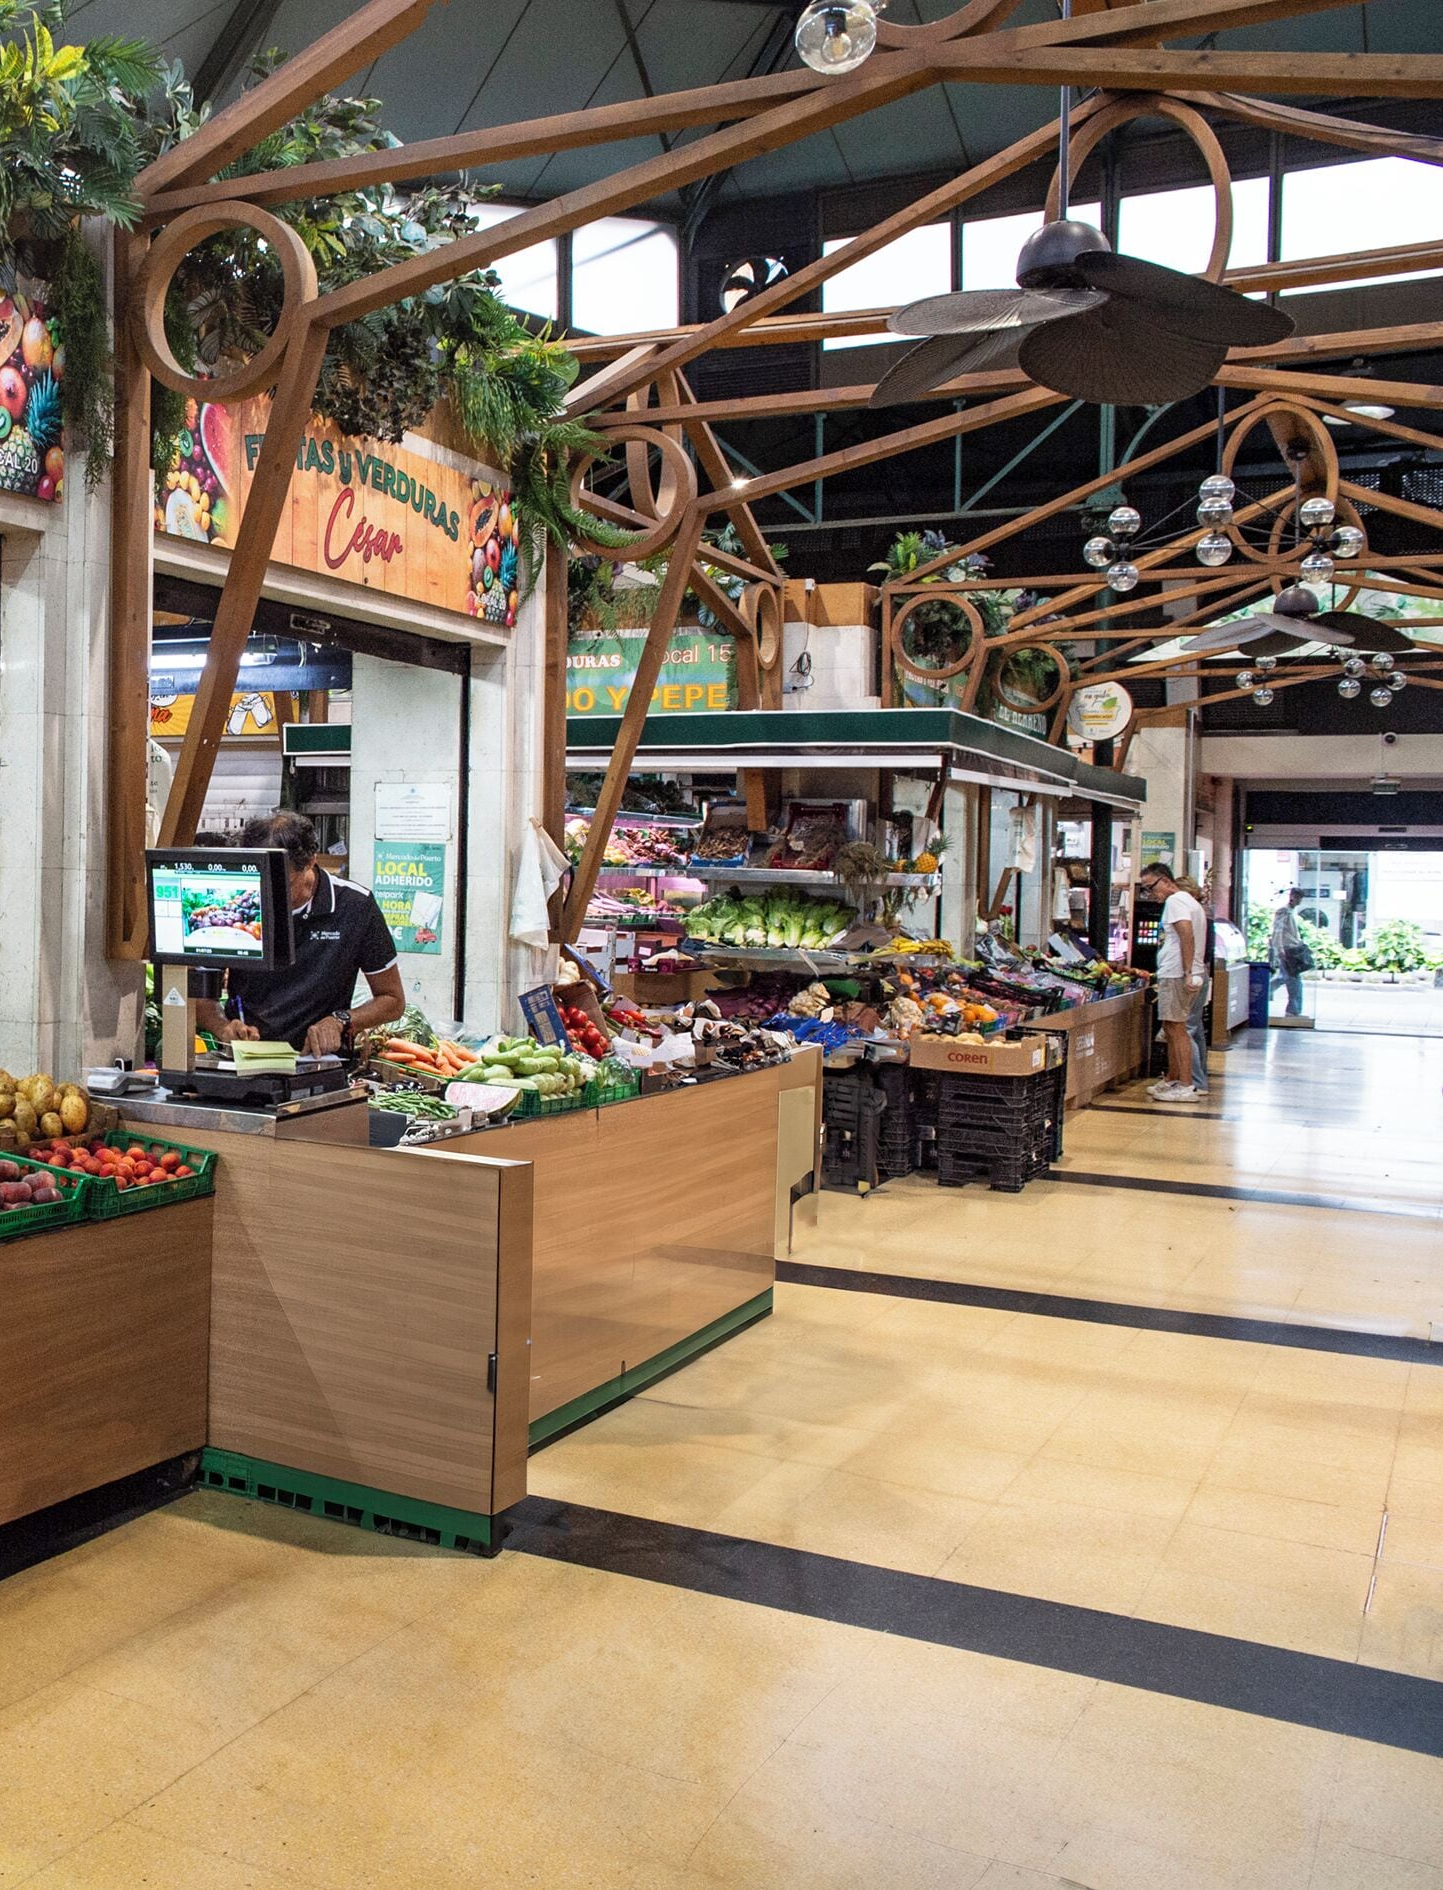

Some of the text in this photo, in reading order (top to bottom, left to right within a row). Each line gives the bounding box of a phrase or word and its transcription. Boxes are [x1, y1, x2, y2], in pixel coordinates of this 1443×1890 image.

[24, 457, 38, 474] 20
[244, 433, 460, 542] FTAS y VERDURAS
[324, 487, 403, 570] César
[661, 644, 698, 664] ocal
[707, 644, 732, 664] 15
[607, 686, 628, 711] Y
[386, 852, 413, 861] Mercado
[420, 854, 442, 863] Puerto
[377, 861, 427, 877] LOCAL
[375, 875, 433, 887] ADHERIDO
[156, 885, 179, 899] 951
[382, 900, 411, 911] HORA
